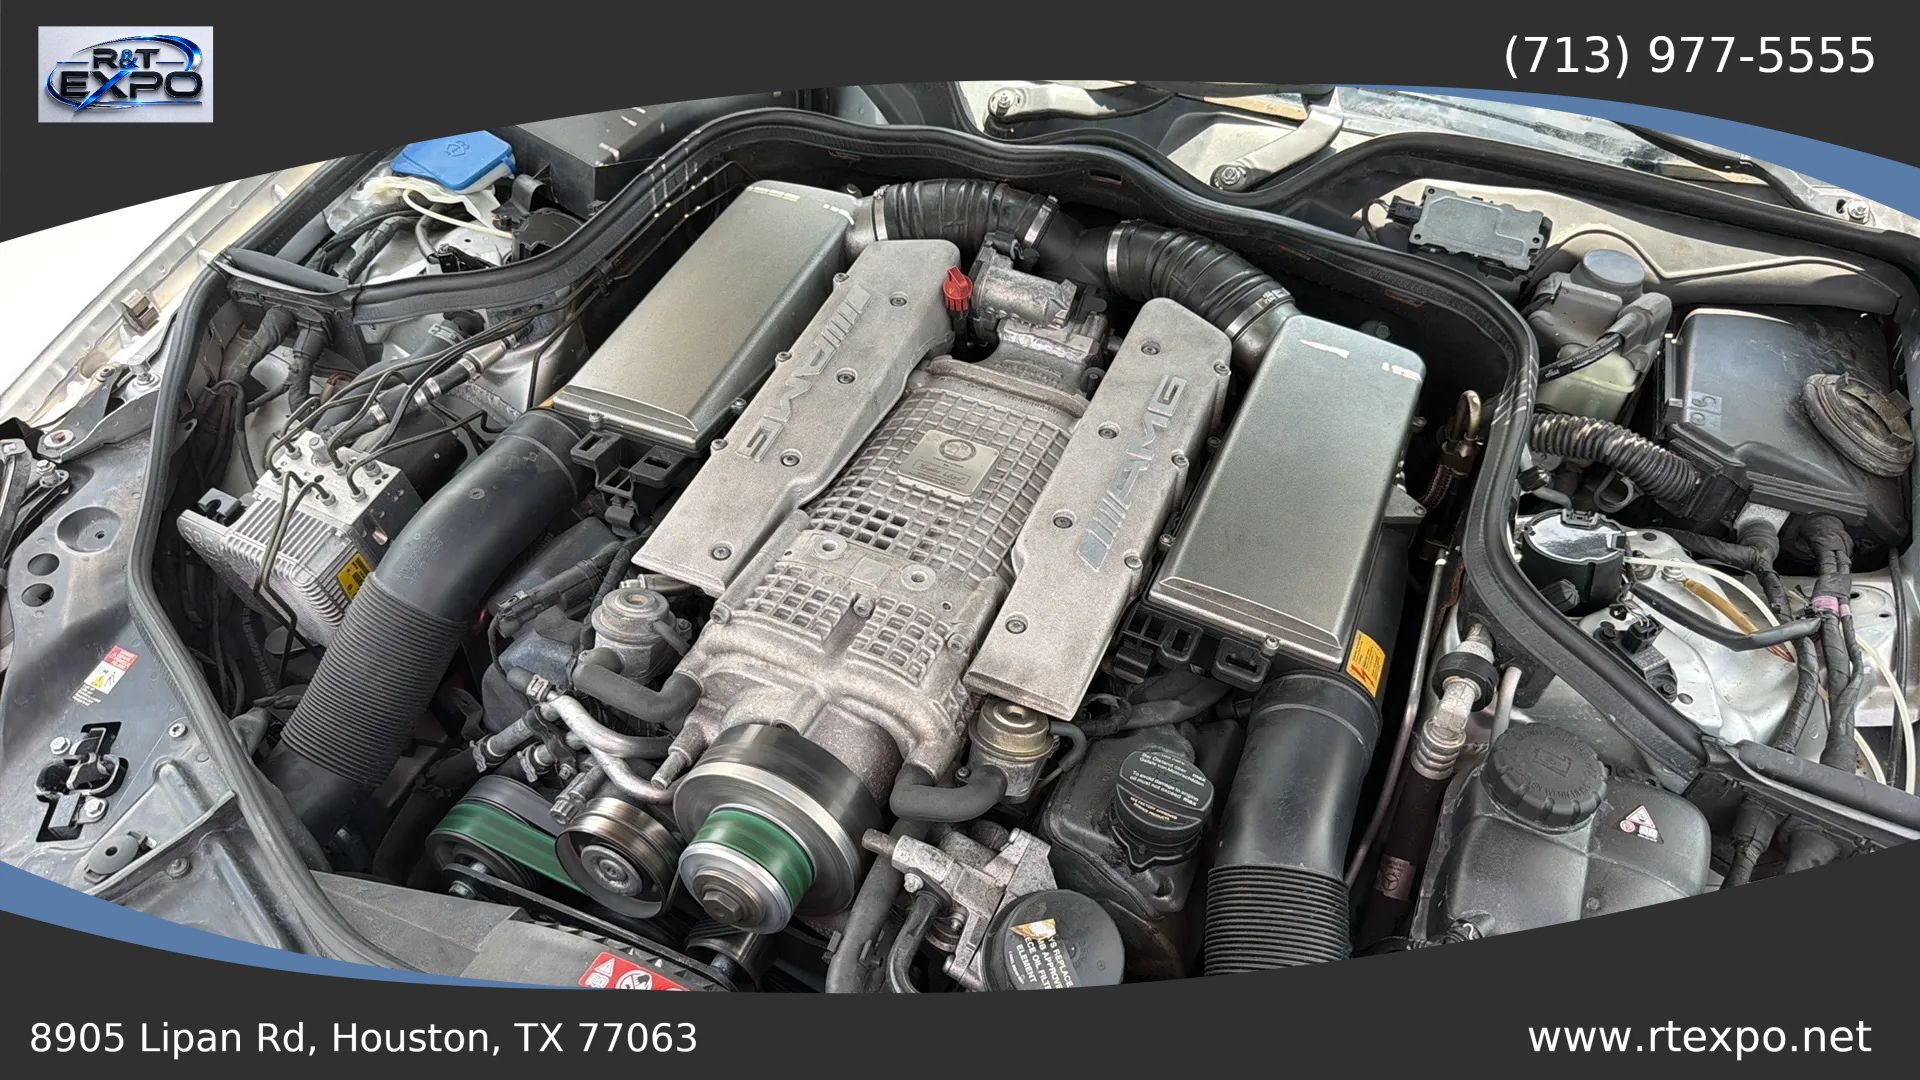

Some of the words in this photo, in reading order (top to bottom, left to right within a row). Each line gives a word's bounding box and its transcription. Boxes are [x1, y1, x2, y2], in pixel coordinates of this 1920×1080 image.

[1139, 757, 1157, 766] Gefahr
[1139, 774, 1155, 782] avoid
[1154, 779, 1175, 790] damage
[1181, 791, 1199, 802] engine
[1192, 773, 1206, 782] max
[1136, 778, 1151, 786] must
[1160, 787, 1182, 799] exceed
[1183, 797, 1197, 806] max
[1016, 943, 1037, 982] ELEMENT
[1024, 935, 1037, 954] ECE
[1032, 955, 1042, 970] OIL
[1053, 948, 1074, 988] REPLACE
